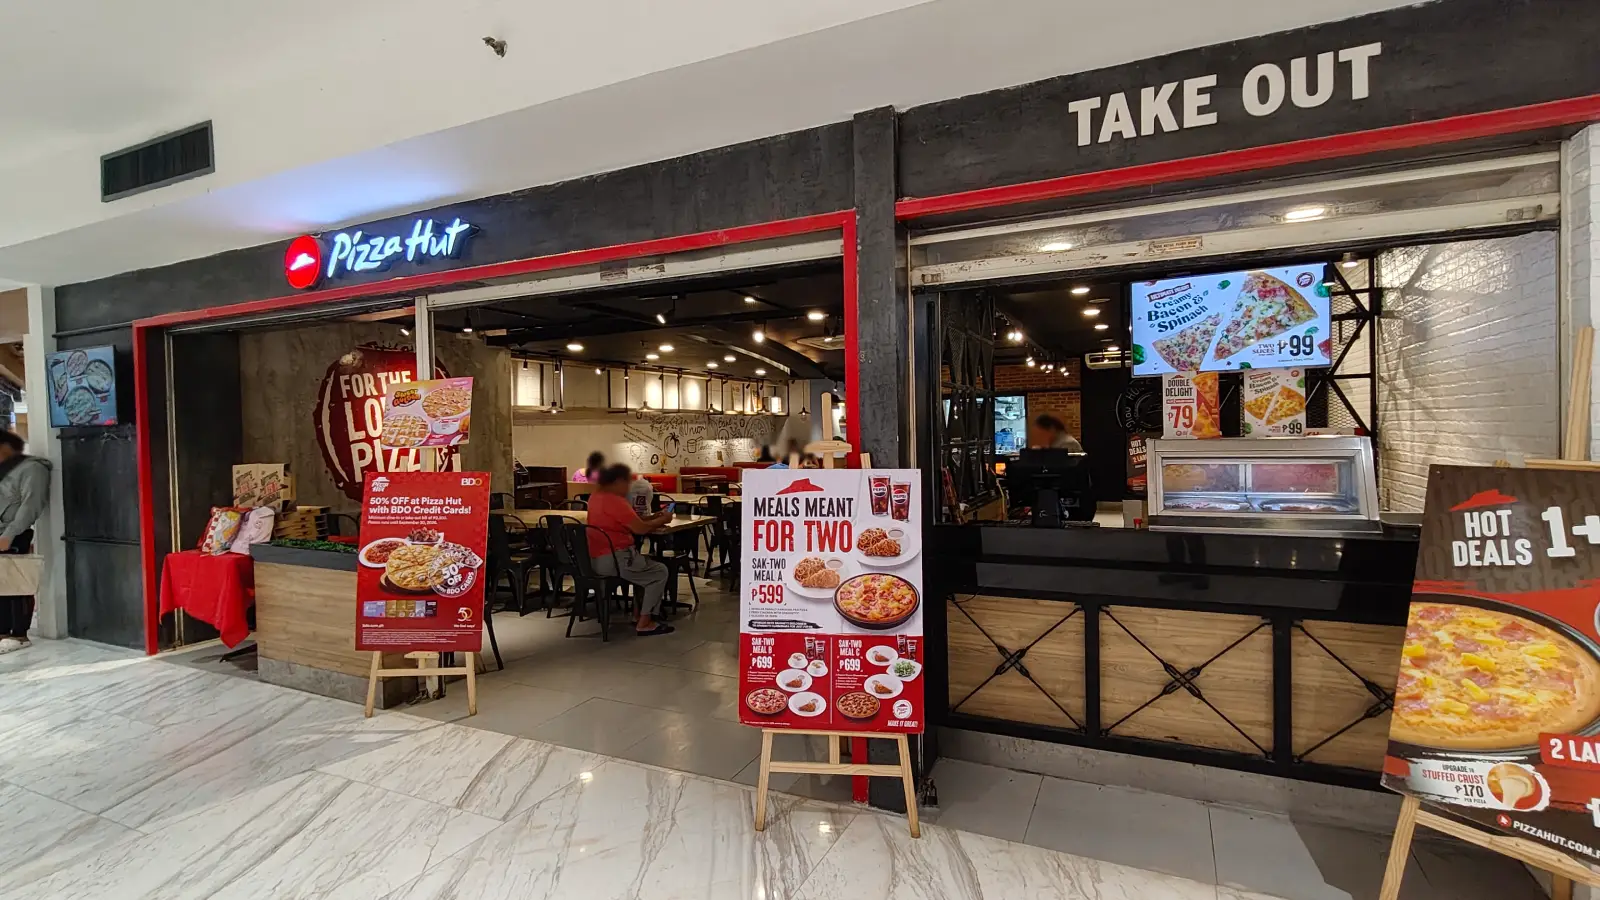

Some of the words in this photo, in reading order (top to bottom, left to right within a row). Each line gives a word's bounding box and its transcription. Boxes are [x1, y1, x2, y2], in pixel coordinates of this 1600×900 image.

[1068, 74, 1218, 147] TAKE
[1242, 42, 1382, 117] OUT
[327, 230, 402, 278] Pizza
[405, 218, 470, 262] Hut
[1147, 302, 1192, 322] Bacon
[1192, 294, 1203, 305] &
[1154, 293, 1192, 309] Creamy
[1157, 305, 1209, 333] Spinach
[340, 373, 378, 398] FOR
[1168, 379, 1190, 387] DOUBLE
[1165, 387, 1193, 397] DELIGHT
[1128, 446, 1146, 456] DEALS
[461, 477, 483, 486] BDO
[369, 497, 389, 505] 50%
[391, 497, 409, 505] OFF
[410, 497, 419, 505] at
[421, 497, 444, 505] Pizza
[445, 497, 462, 505] Hut
[753, 497, 799, 518] MEALS
[805, 497, 854, 518] MEANT
[369, 505, 389, 514] with
[390, 506, 411, 514] BDO
[413, 505, 441, 514] Credit
[442, 506, 472, 514] Cards!
[1463, 509, 1512, 538] HOT
[753, 520, 795, 552] FOR
[804, 520, 853, 553] TWO
[1452, 539, 1533, 567] DEALS
[442, 562, 465, 579] 50%
[751, 558, 786, 570] SAK-TWO
[447, 574, 463, 586] OFF
[754, 570, 774, 581] MEAL
[777, 570, 783, 581] A
[446, 587, 460, 595] BDO
[460, 571, 474, 591] CARDS
[751, 637, 775, 646] SAK-TWO
[838, 639, 862, 648] SAK-TWO
[752, 645, 767, 654] MEAL
[768, 646, 773, 654] B
[839, 648, 855, 656] MEAL
[855, 648, 860, 656] C
[1549, 738, 1565, 760] 2
[1568, 740, 1600, 764] LA
[1442, 764, 1468, 773] UPGRADE
[1422, 769, 1455, 783] STUFFED
[1457, 774, 1484, 785] CRUST
